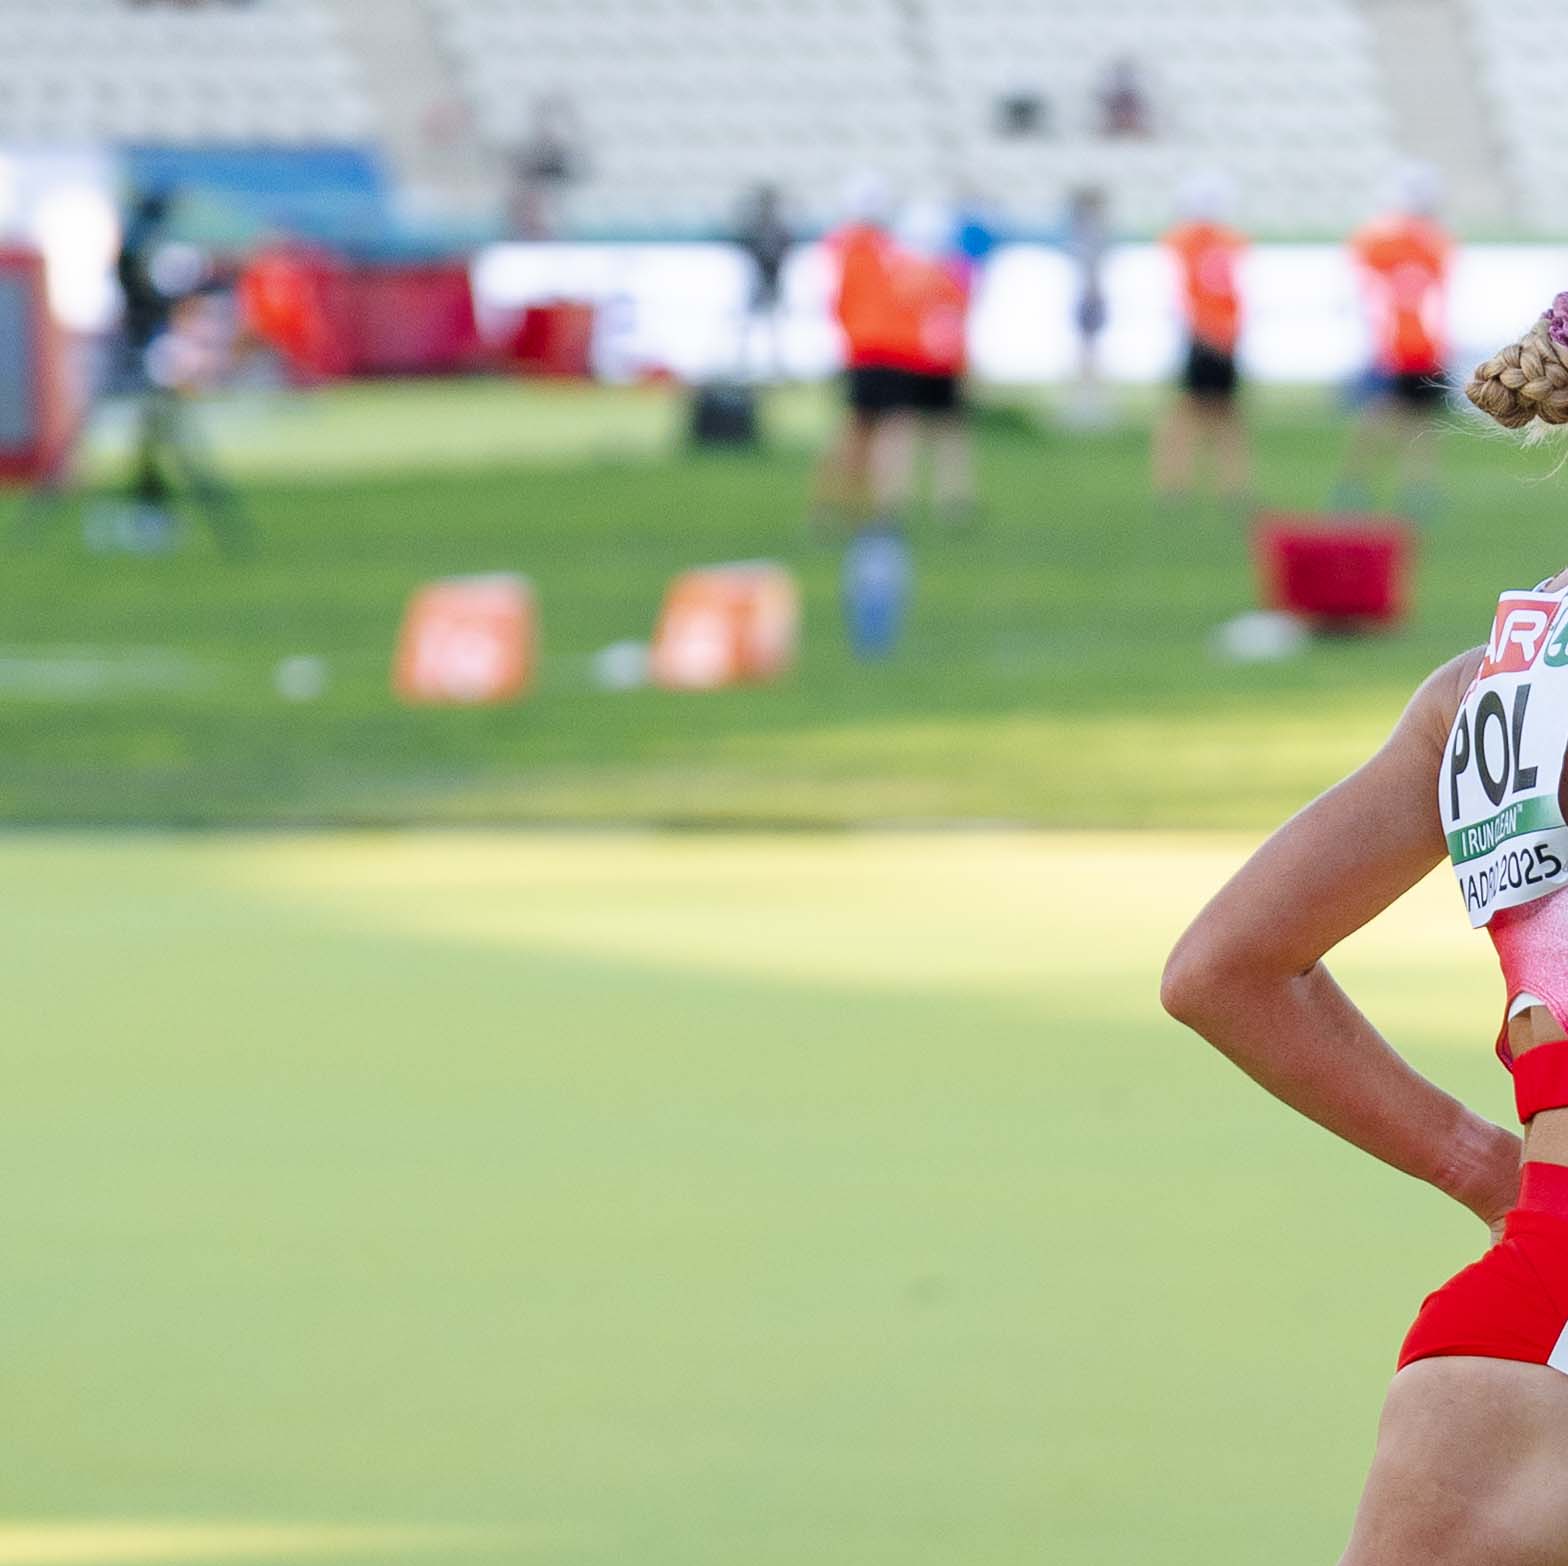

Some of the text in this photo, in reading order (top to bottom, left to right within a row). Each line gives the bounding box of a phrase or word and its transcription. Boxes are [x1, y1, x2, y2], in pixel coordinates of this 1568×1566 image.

[1451, 683, 1538, 821] POL
[1468, 821, 1495, 856] RUN
[1498, 843, 1562, 892] 2025
